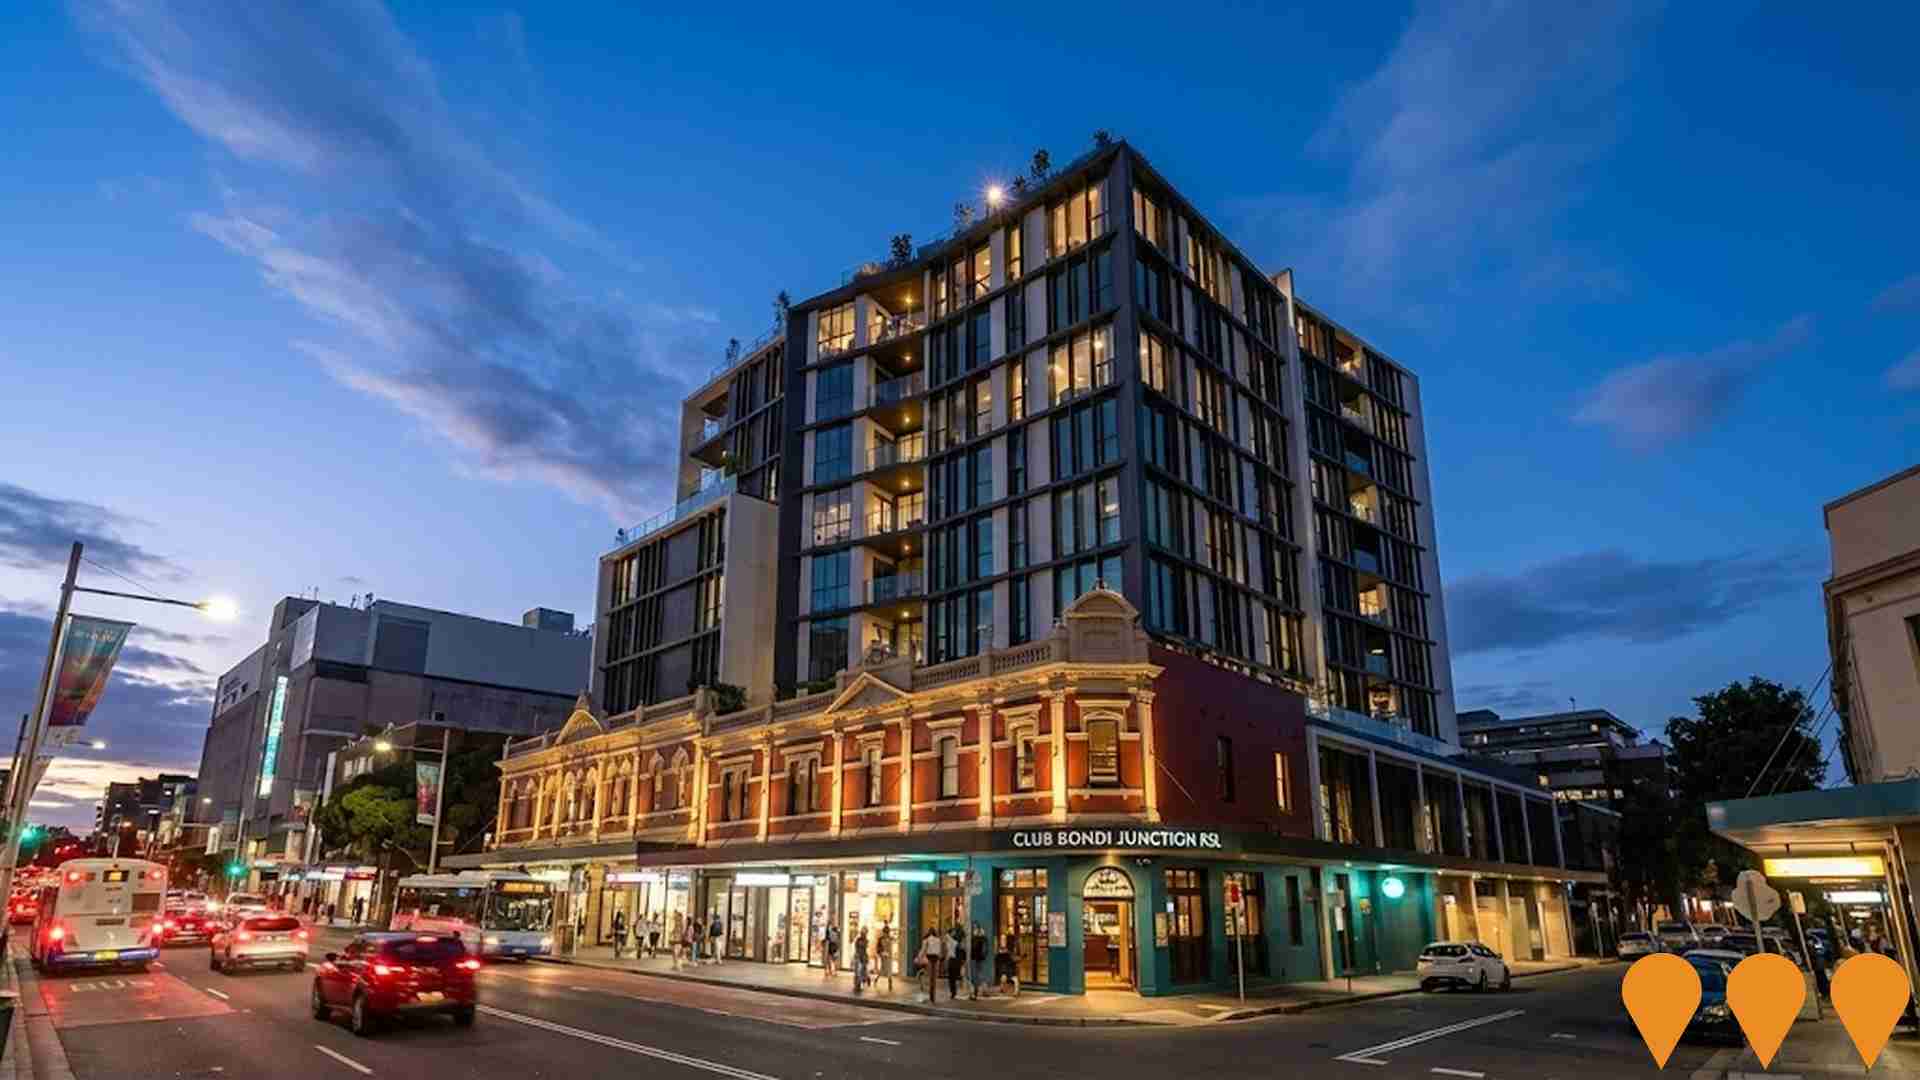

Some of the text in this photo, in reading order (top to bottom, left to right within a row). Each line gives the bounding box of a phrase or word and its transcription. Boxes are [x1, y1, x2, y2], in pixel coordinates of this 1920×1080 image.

[1013, 831, 1222, 848] CLUB BONDI JUNCTION RSL
